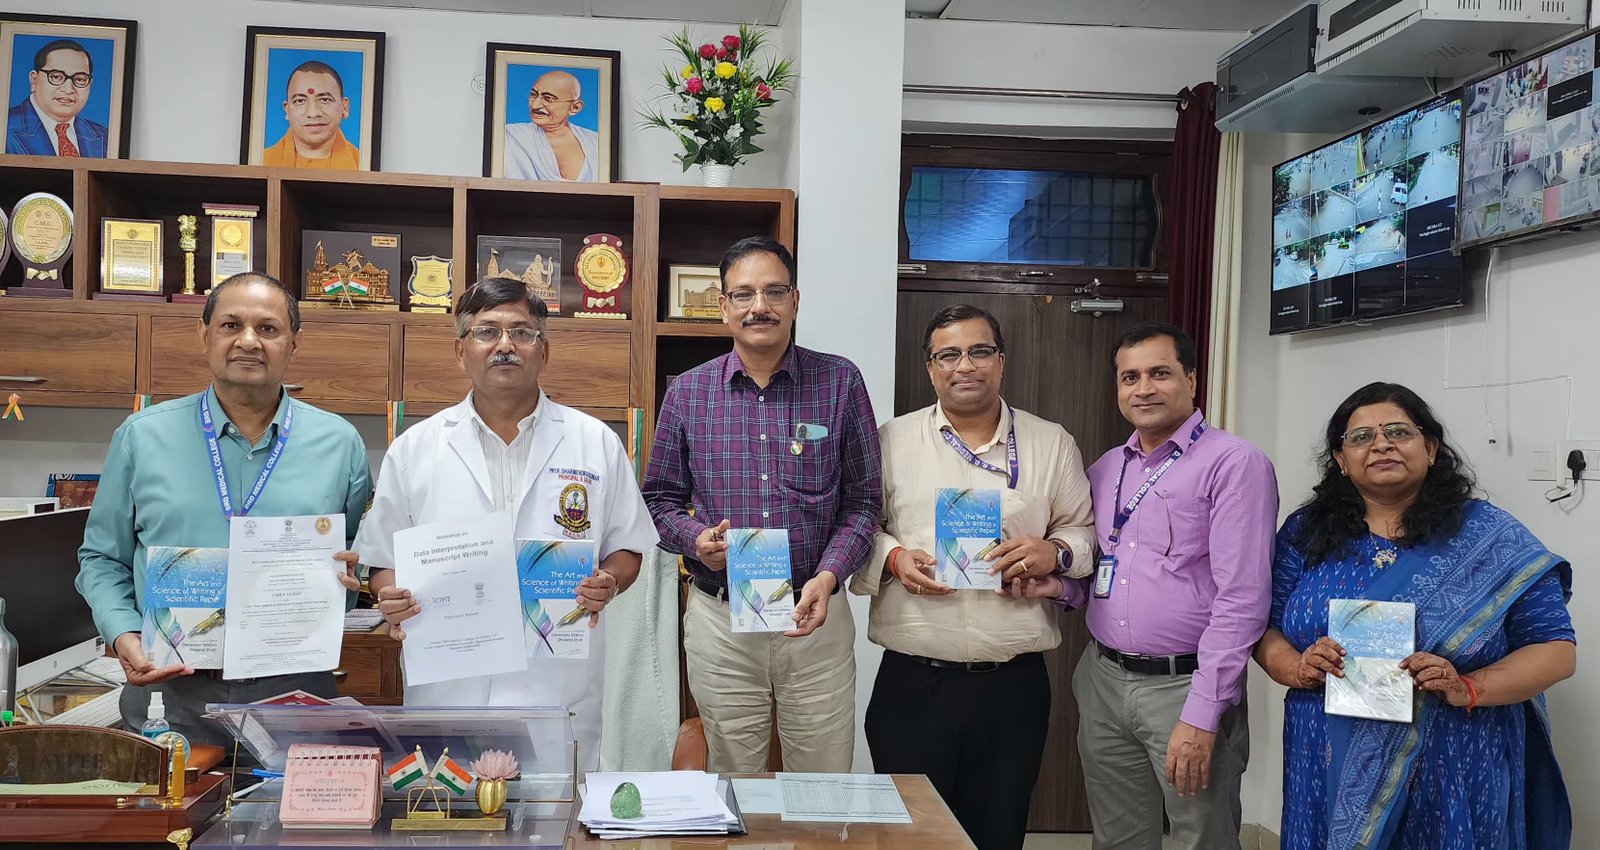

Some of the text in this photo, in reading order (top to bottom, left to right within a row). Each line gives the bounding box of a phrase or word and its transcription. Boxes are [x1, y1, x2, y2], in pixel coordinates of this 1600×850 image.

[208, 438, 231, 511] BRD MEDICAL COLLEGE
[244, 440, 284, 510] BRD MEDICAL COLLEGE
[1148, 458, 1174, 482] MEDICAL
[1126, 482, 1150, 511] COLLEGE
[421, 549, 488, 565] Manuscript Writing
[431, 542, 478, 554] Interpretation
[191, 587, 215, 596] Writing
